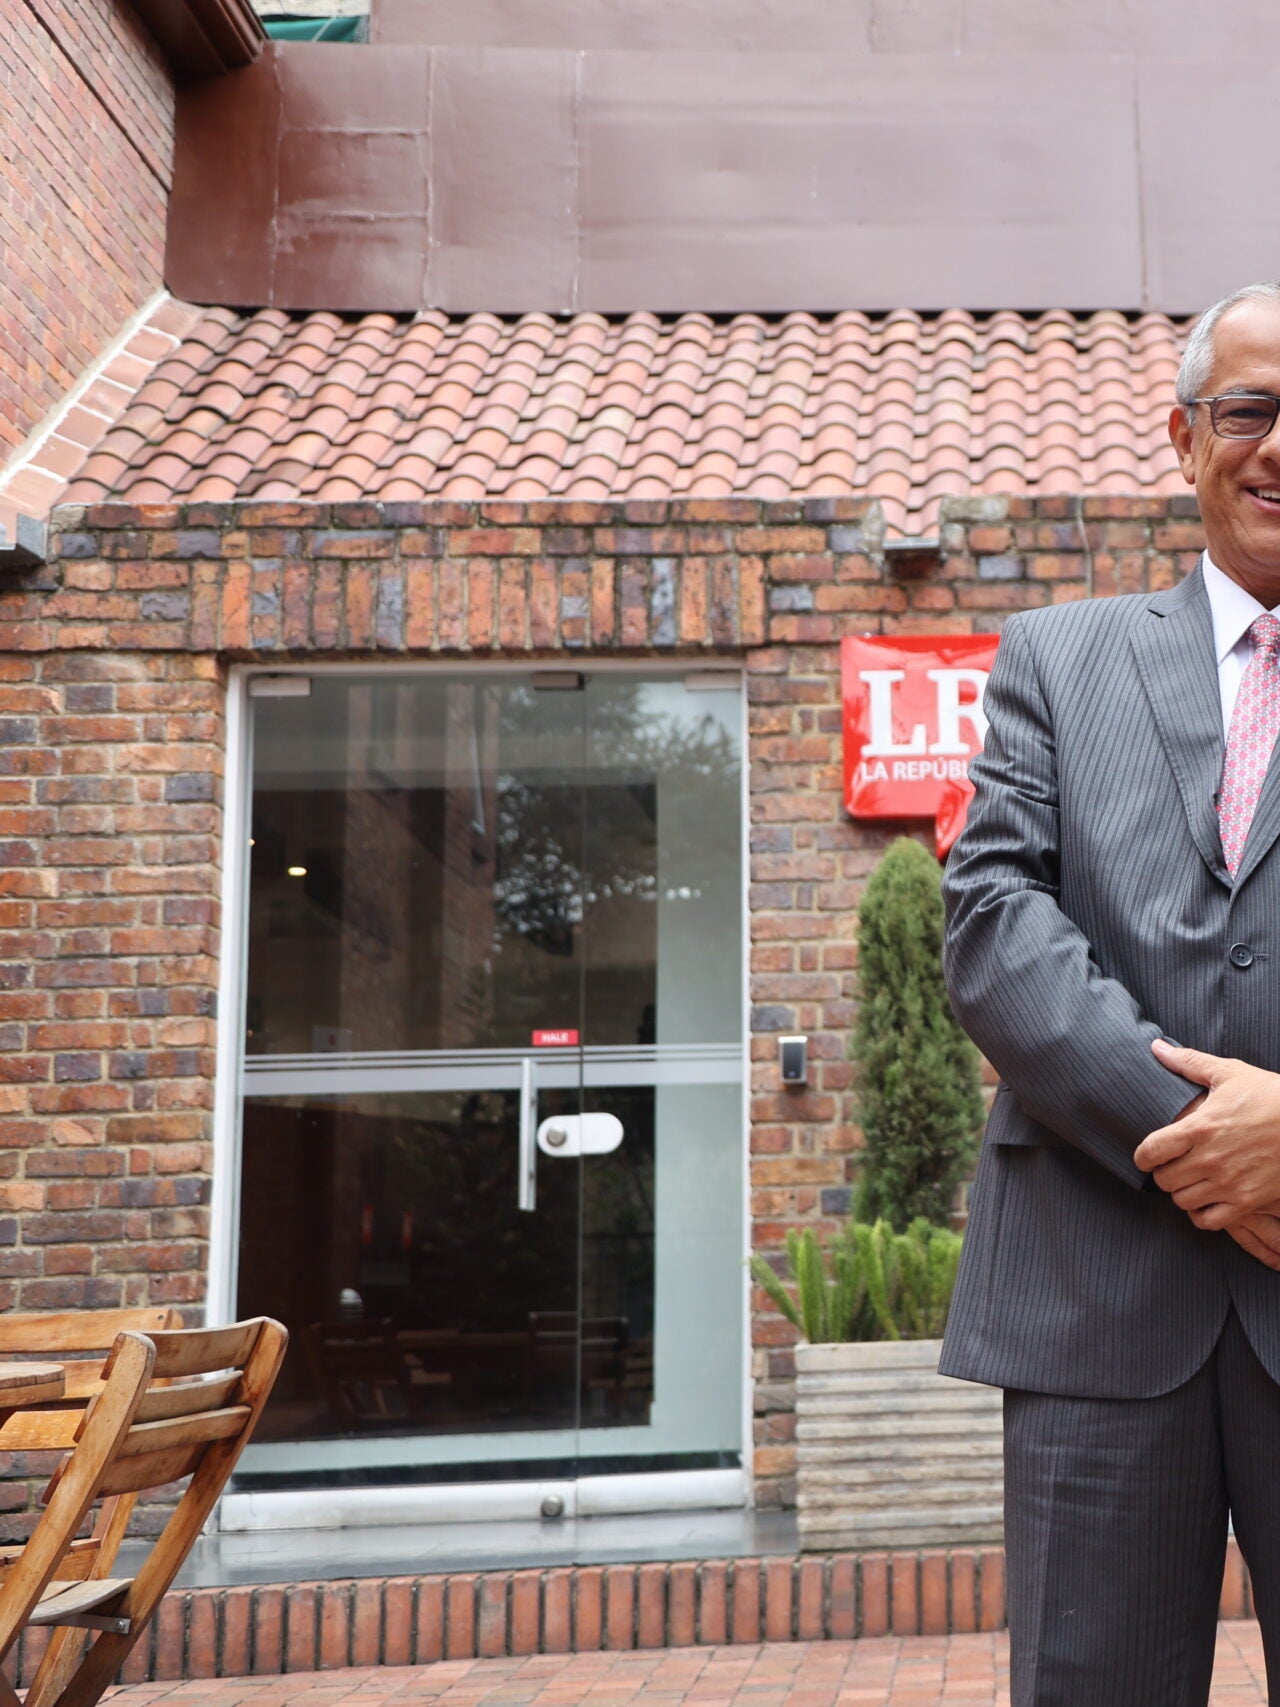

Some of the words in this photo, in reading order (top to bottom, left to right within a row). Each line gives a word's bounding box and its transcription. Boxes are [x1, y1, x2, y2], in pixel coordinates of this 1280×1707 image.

[859, 669, 990, 756] LR
[861, 760, 888, 781] LA
[893, 757, 968, 780] REPÚBL
